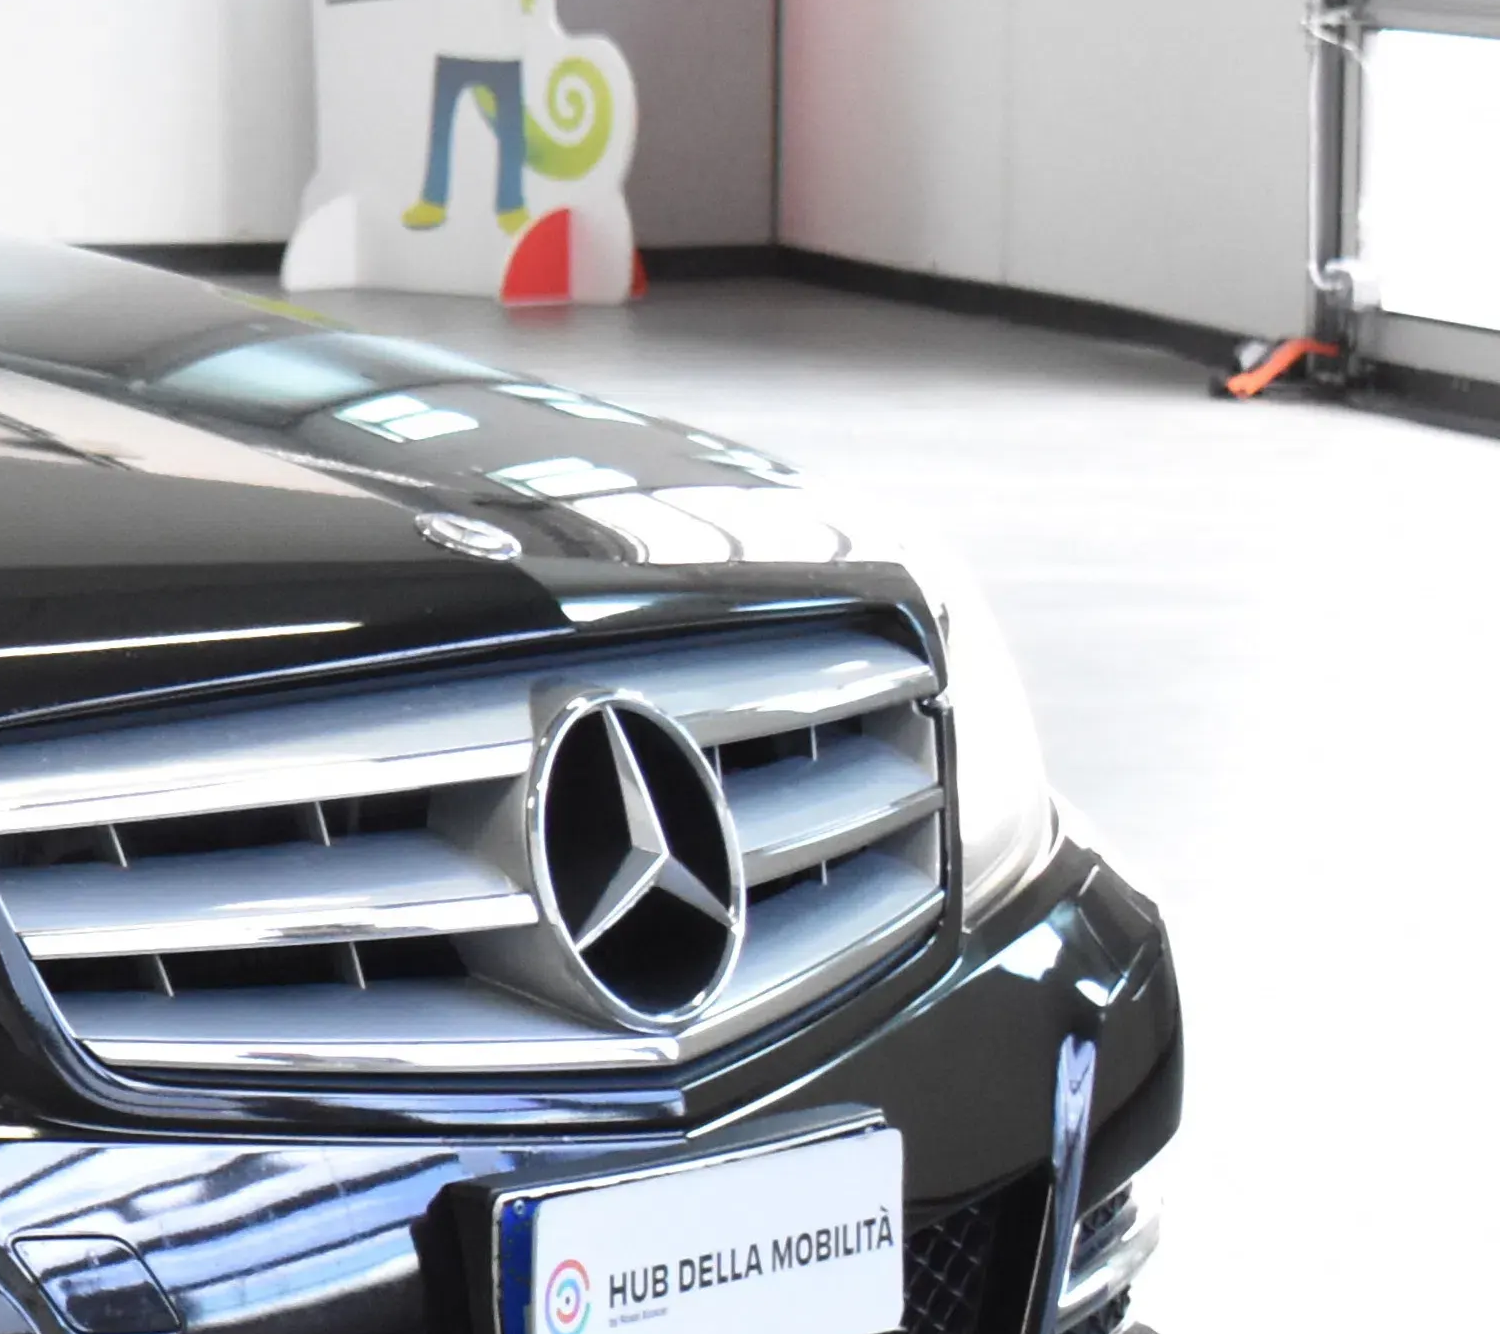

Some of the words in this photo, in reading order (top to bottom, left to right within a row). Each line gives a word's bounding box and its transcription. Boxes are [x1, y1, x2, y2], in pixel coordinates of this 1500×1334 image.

[609, 1264, 669, 1309] HUB
[678, 1244, 764, 1293] DELLA
[772, 1205, 895, 1272] MOBILITÀ
